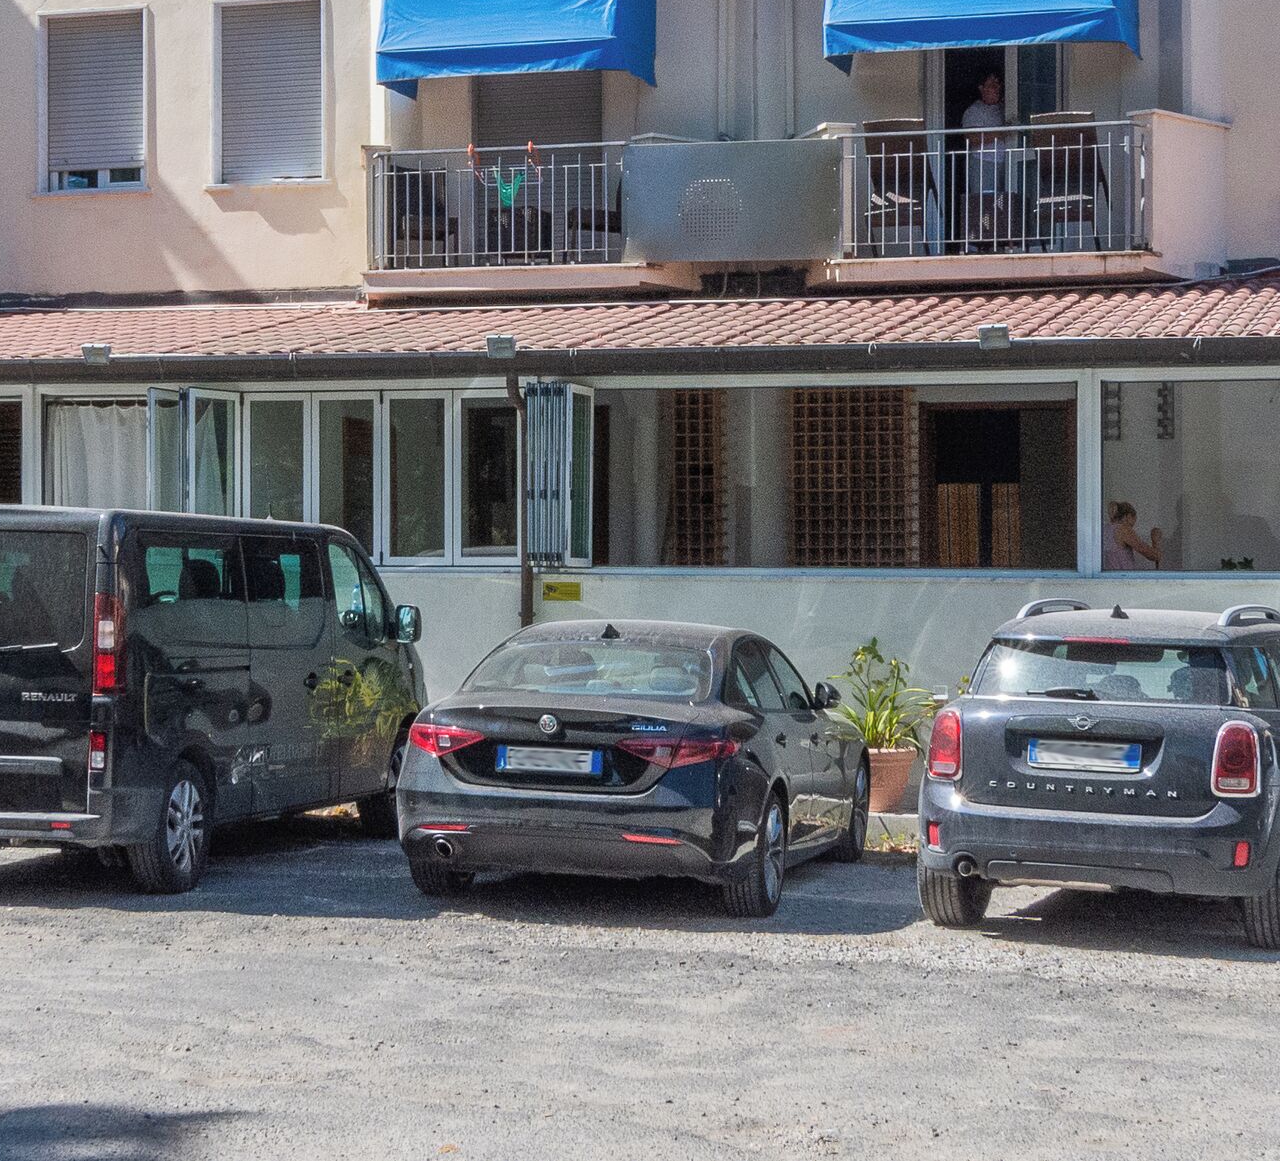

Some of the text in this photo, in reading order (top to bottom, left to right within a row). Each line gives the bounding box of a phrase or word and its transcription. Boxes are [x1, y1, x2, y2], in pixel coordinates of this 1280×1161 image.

[21, 691, 77, 701] RENAULT
[631, 724, 667, 732] GIULIA
[989, 780, 1178, 798] COUNTRYMAN
